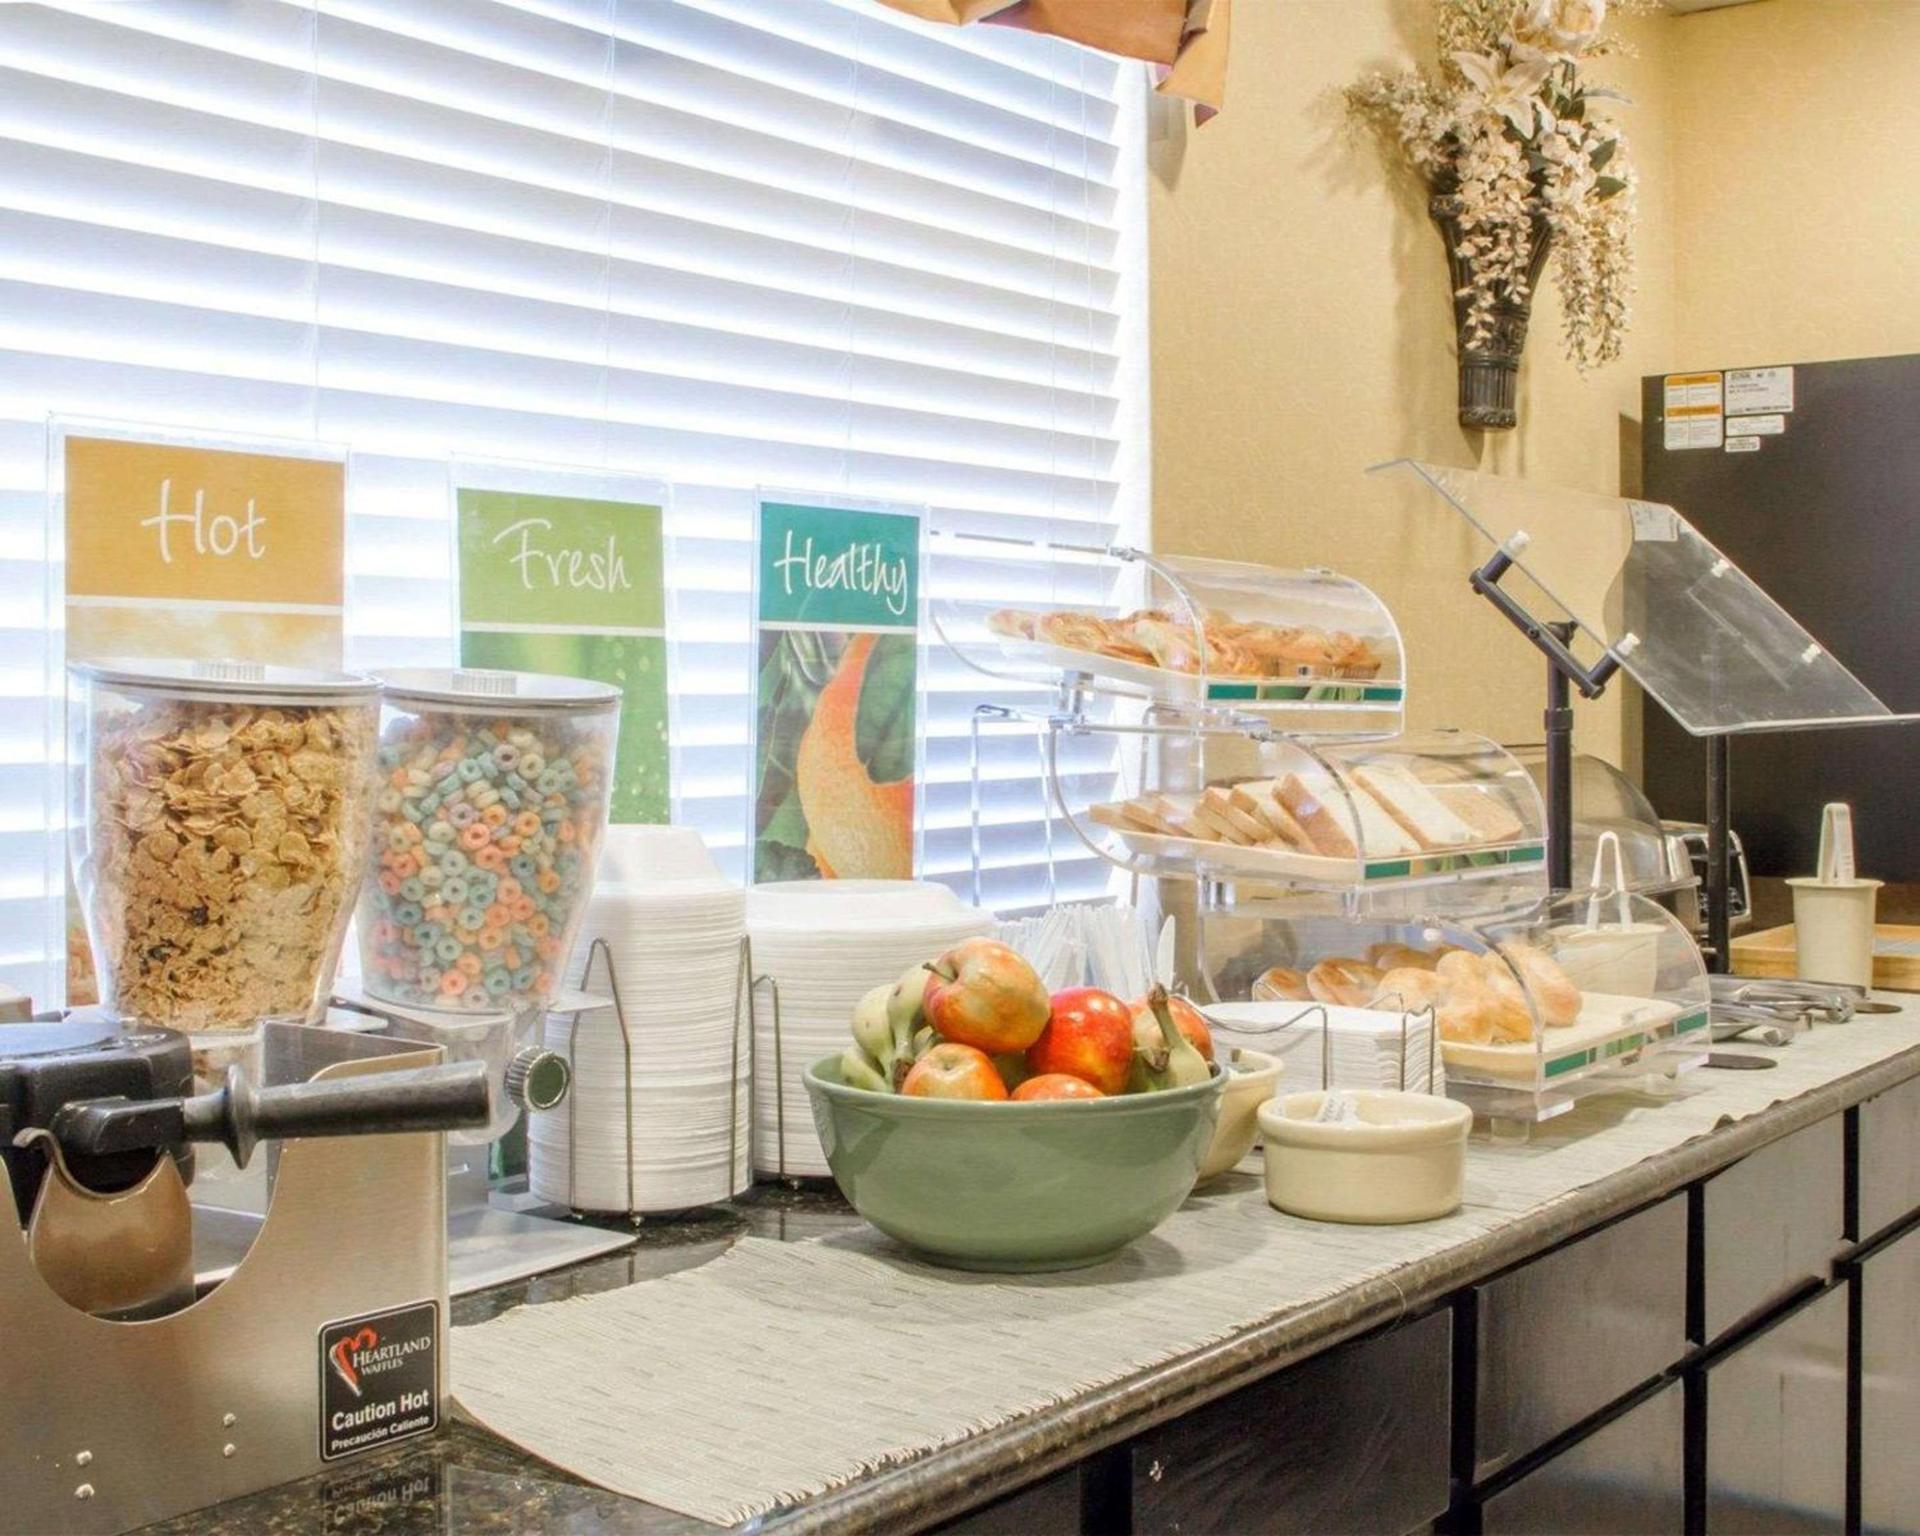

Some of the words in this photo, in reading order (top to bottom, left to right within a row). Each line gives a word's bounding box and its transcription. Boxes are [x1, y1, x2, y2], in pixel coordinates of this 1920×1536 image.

[140, 478, 266, 564] Hot
[493, 517, 631, 592] Fresh
[774, 529, 907, 615] Healthy
[353, 1336, 431, 1368] HEARTLAND
[361, 1358, 404, 1376] WAFFLES
[332, 1401, 396, 1431] Caution
[400, 1389, 429, 1412] Hot
[389, 1415, 430, 1434] Caliente
